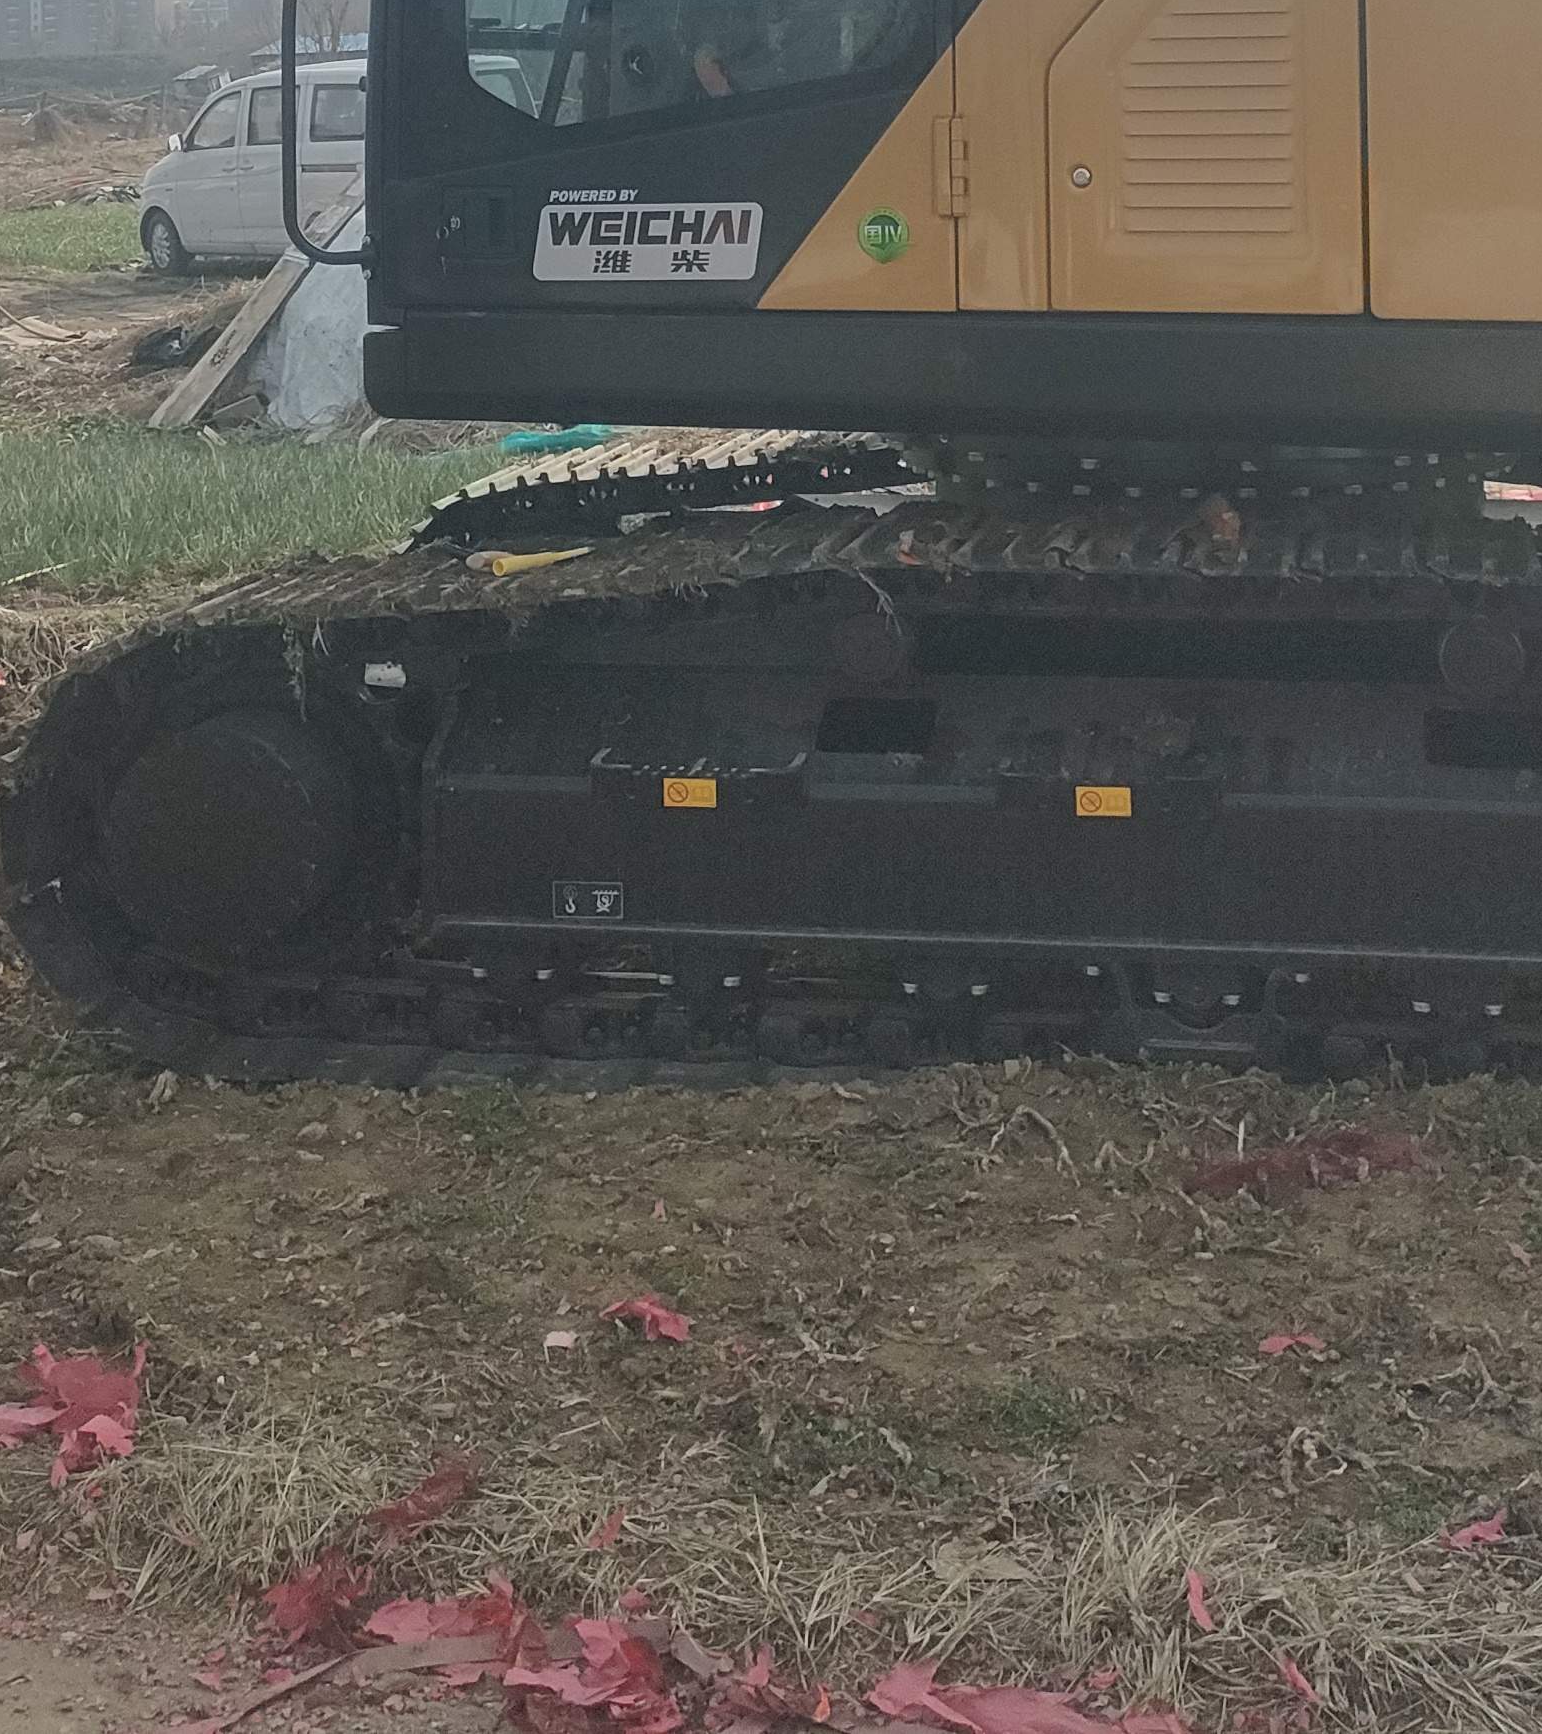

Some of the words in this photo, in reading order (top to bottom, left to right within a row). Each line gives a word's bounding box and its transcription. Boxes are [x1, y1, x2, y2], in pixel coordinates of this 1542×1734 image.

[549, 189, 615, 203] POWERED
[619, 189, 639, 202] BY
[549, 209, 752, 246] WEICHAI
